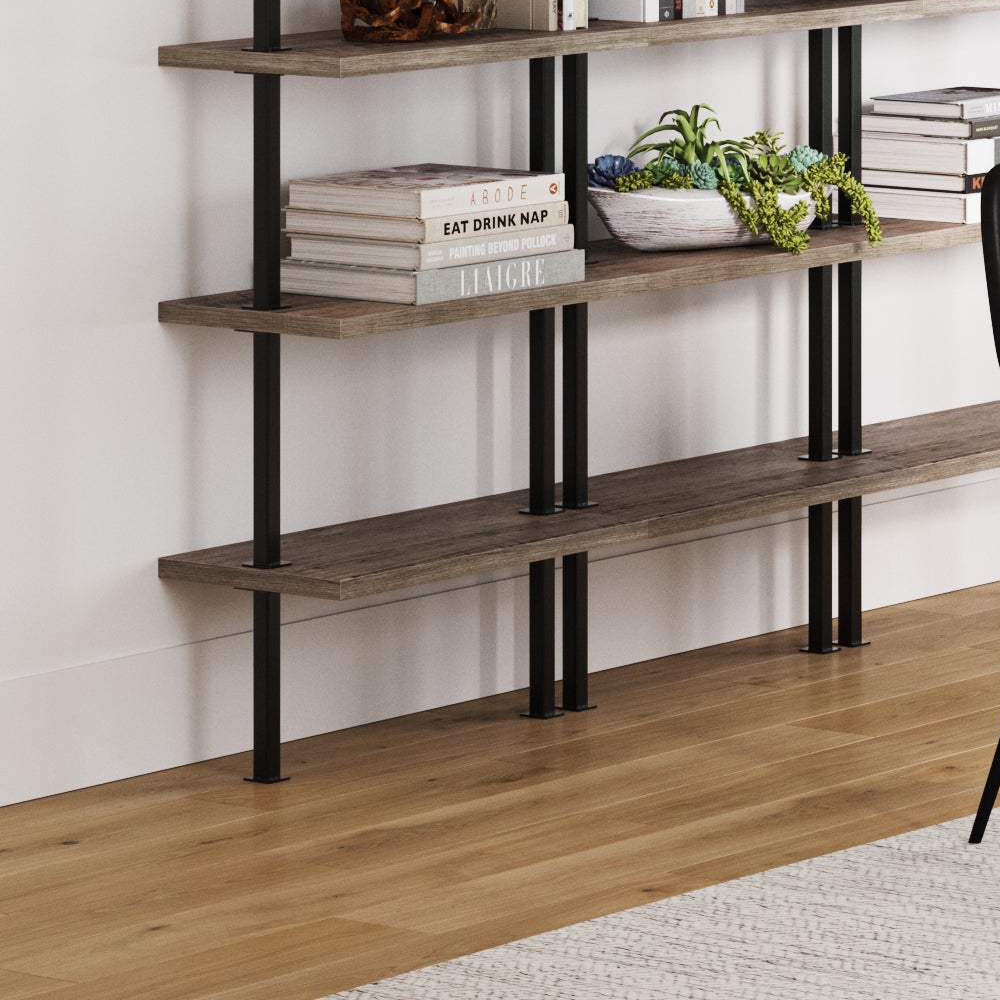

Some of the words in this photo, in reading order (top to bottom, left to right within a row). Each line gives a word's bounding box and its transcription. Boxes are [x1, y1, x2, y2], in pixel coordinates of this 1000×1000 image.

[470, 184, 528, 206] ABODE
[444, 220, 468, 236] EAT
[473, 214, 516, 232] DRINK
[520, 210, 548, 225] NAP
[450, 244, 486, 260] PAINTING
[488, 238, 520, 254] BEYOND
[522, 234, 557, 250] POLLOCK
[460, 258, 545, 296] LIAIGRE
